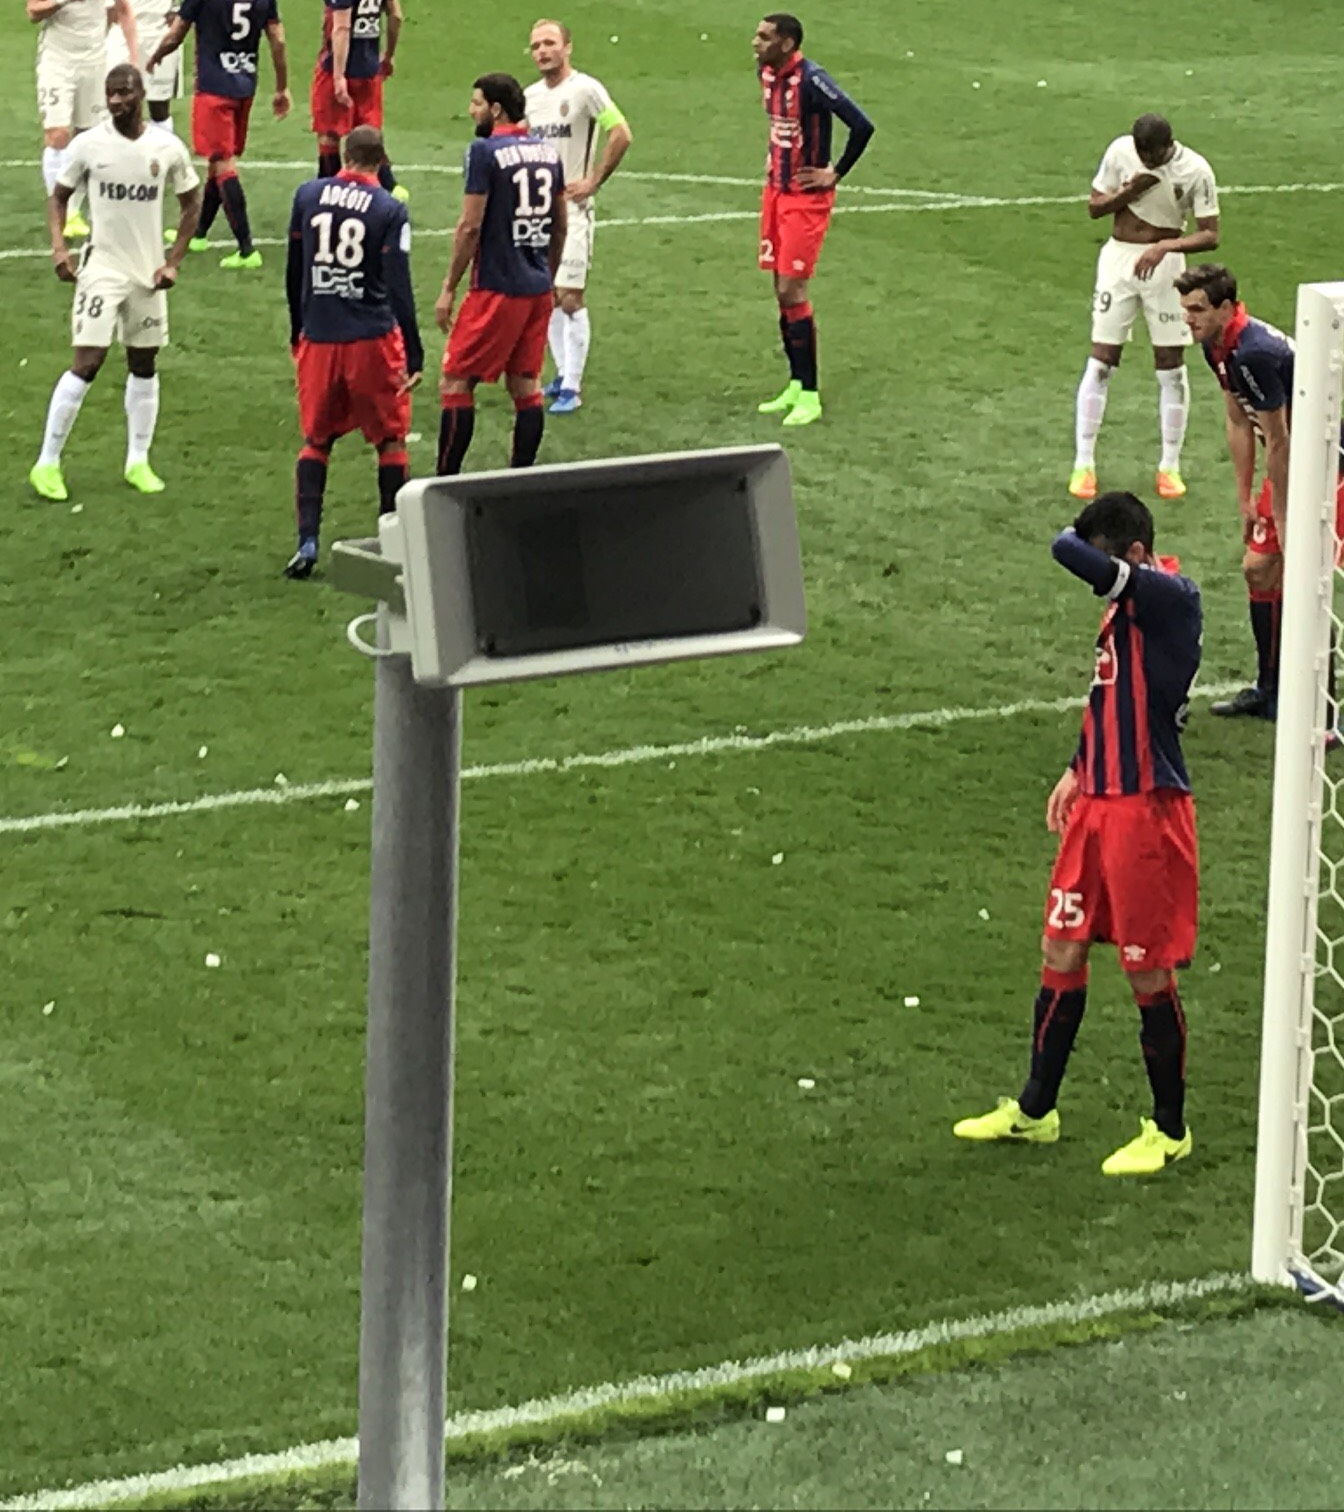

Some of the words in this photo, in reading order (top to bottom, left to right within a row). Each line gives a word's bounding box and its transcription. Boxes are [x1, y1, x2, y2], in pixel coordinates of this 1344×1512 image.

[231, 2, 252, 40] 5
[512, 168, 552, 216] 13
[310, 212, 365, 268] 18
[76, 292, 104, 319] 38
[1048, 889, 1086, 929] 25
